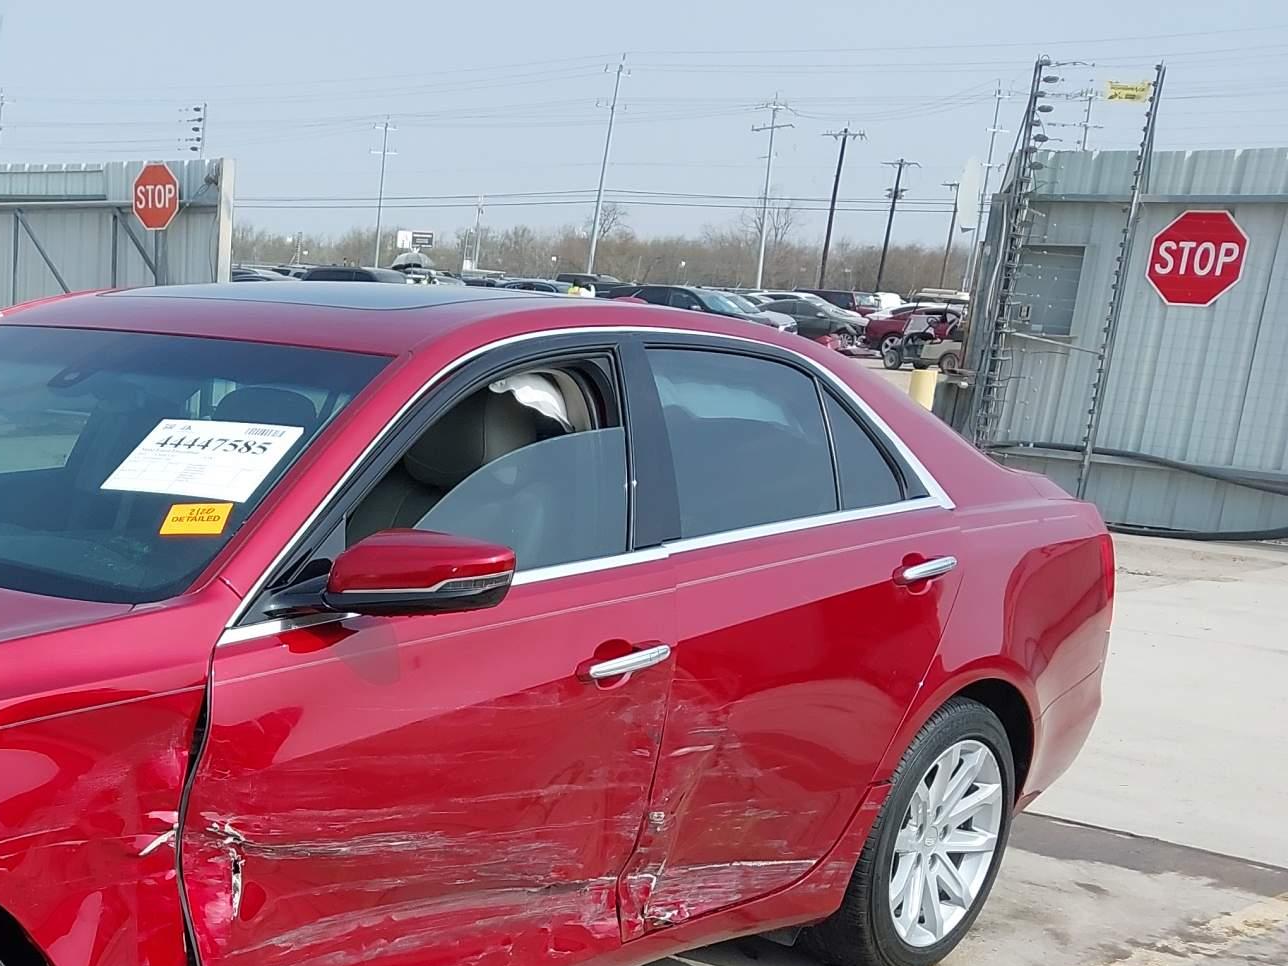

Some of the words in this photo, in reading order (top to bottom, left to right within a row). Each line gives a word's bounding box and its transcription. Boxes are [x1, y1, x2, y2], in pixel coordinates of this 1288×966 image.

[136, 184, 175, 209] STOP
[1154, 240, 1239, 276] STOP
[155, 435, 272, 456] 44447585
[171, 515, 221, 523] DETAILED
